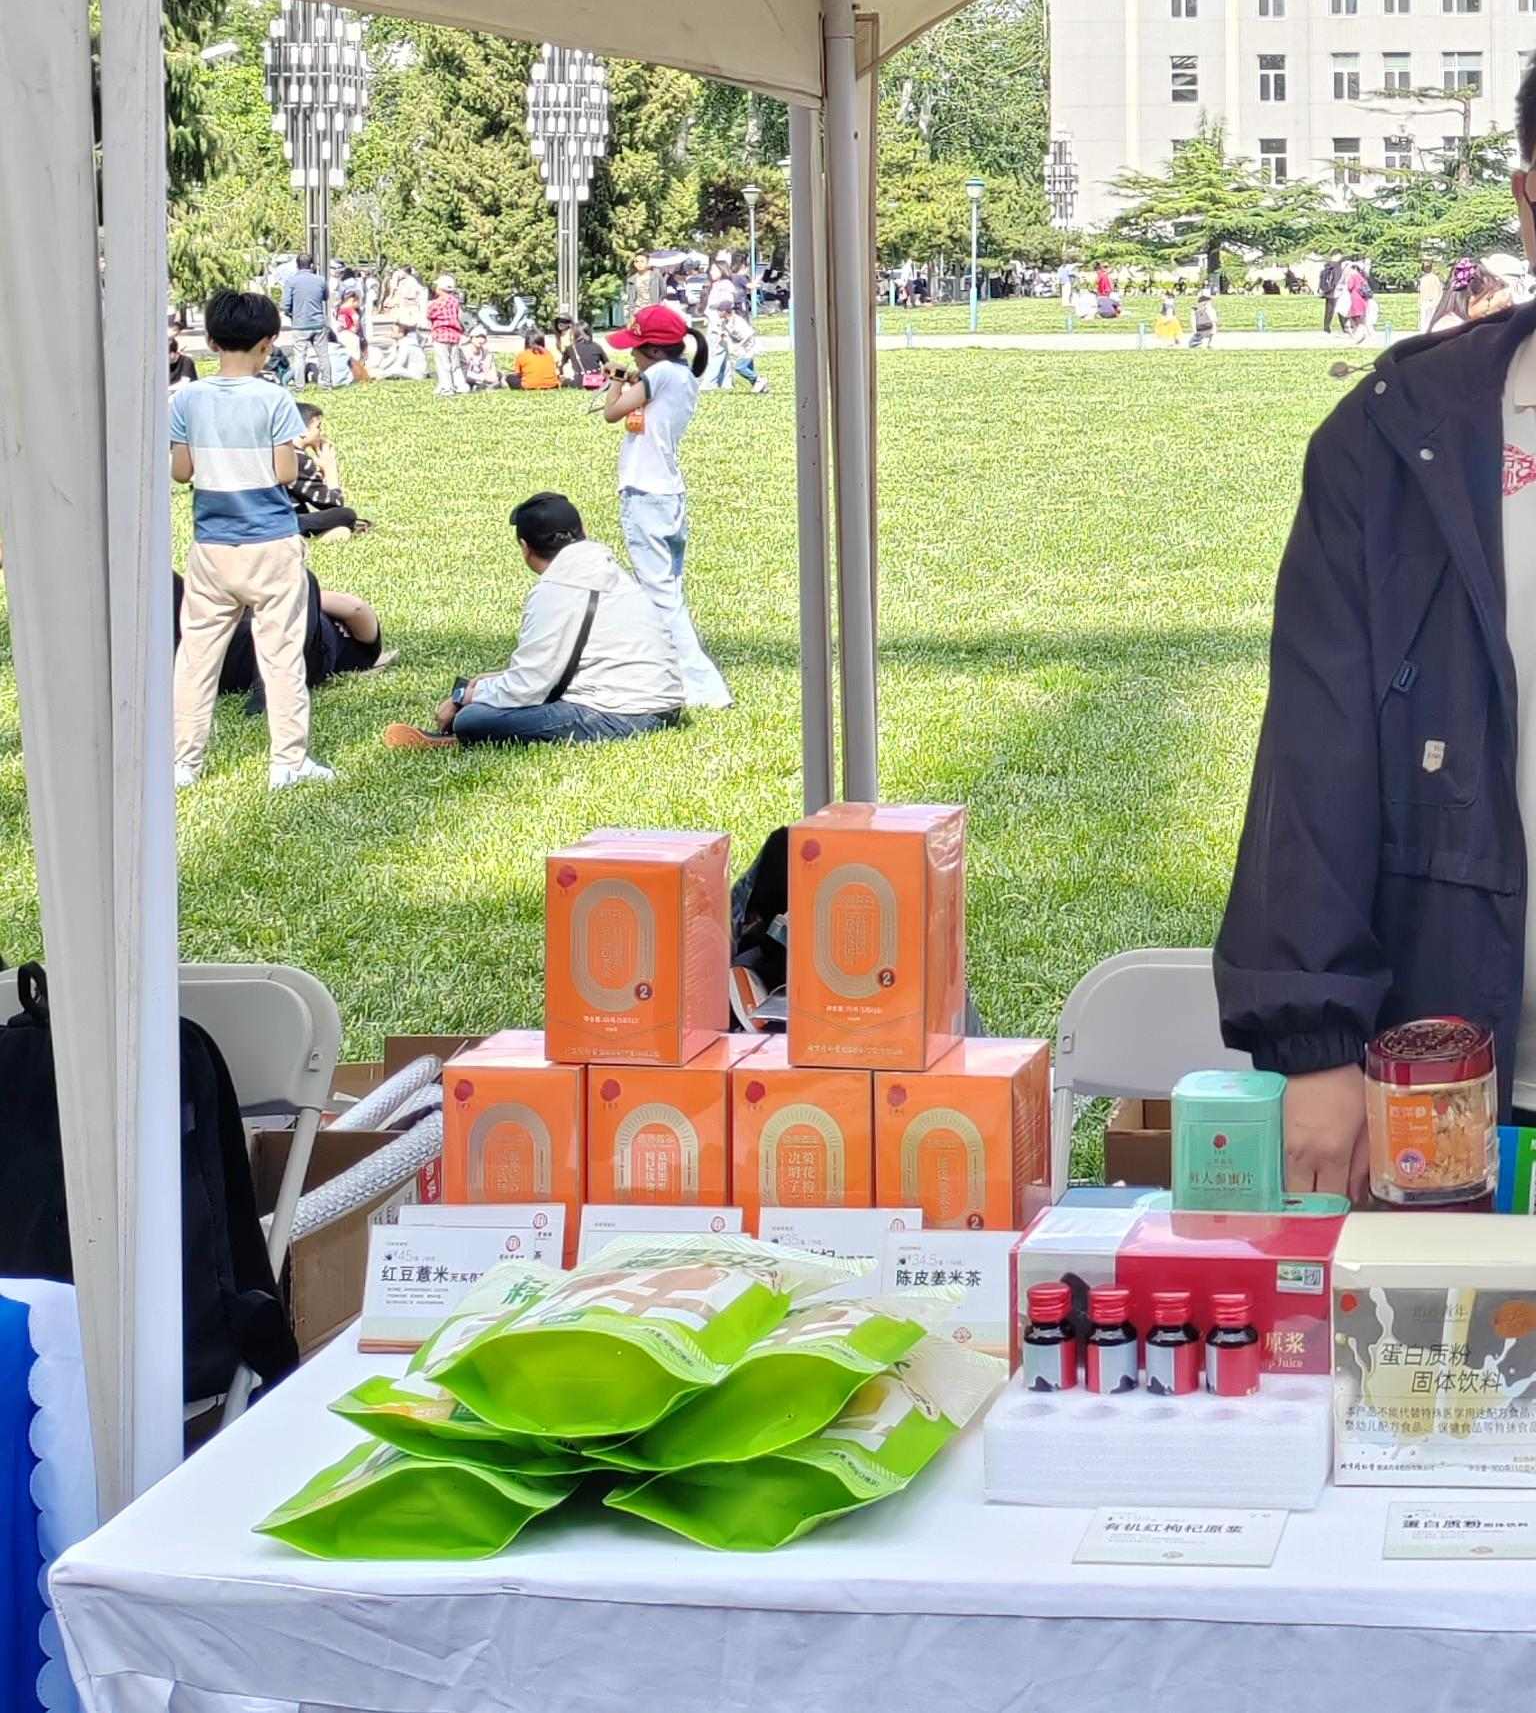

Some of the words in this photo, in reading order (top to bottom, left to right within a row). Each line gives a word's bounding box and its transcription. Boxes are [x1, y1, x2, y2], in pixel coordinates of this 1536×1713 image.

[896, 1269, 982, 1287] 陈皮姜米茶
[1379, 1343, 1472, 1366] 蛋白质粉
[1411, 1370, 1503, 1393] 固体饮料
